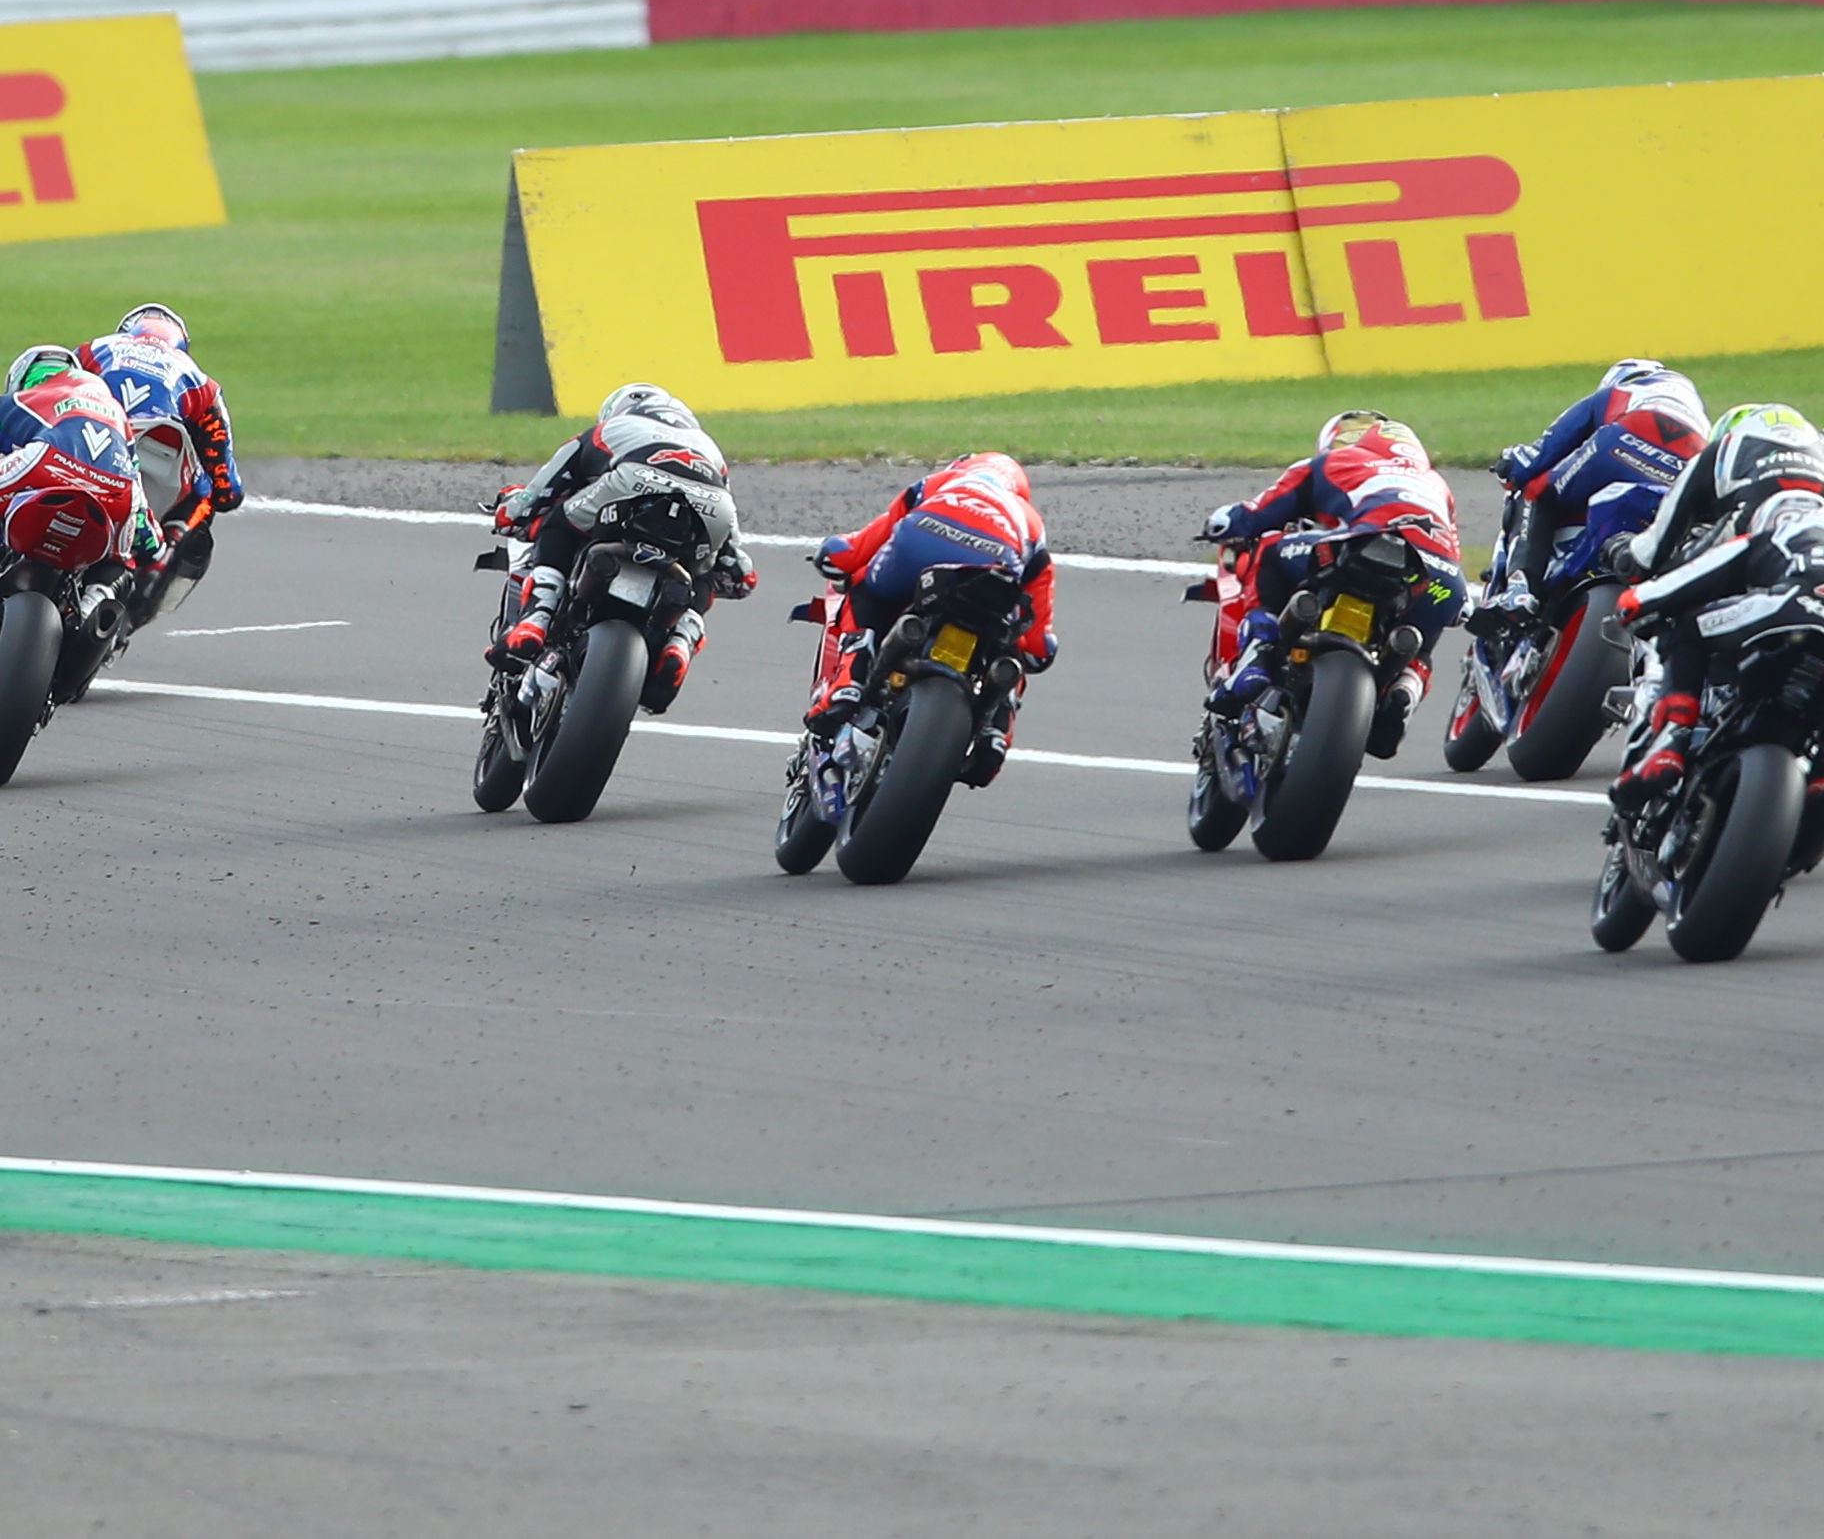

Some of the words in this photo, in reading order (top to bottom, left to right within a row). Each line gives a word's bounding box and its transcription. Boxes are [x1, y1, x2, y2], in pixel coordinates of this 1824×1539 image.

[696, 155, 1531, 363] PIRELLI
[53, 453, 86, 475] FRANK
[88, 470, 126, 490] THOMAS
[600, 504, 618, 524] 46
